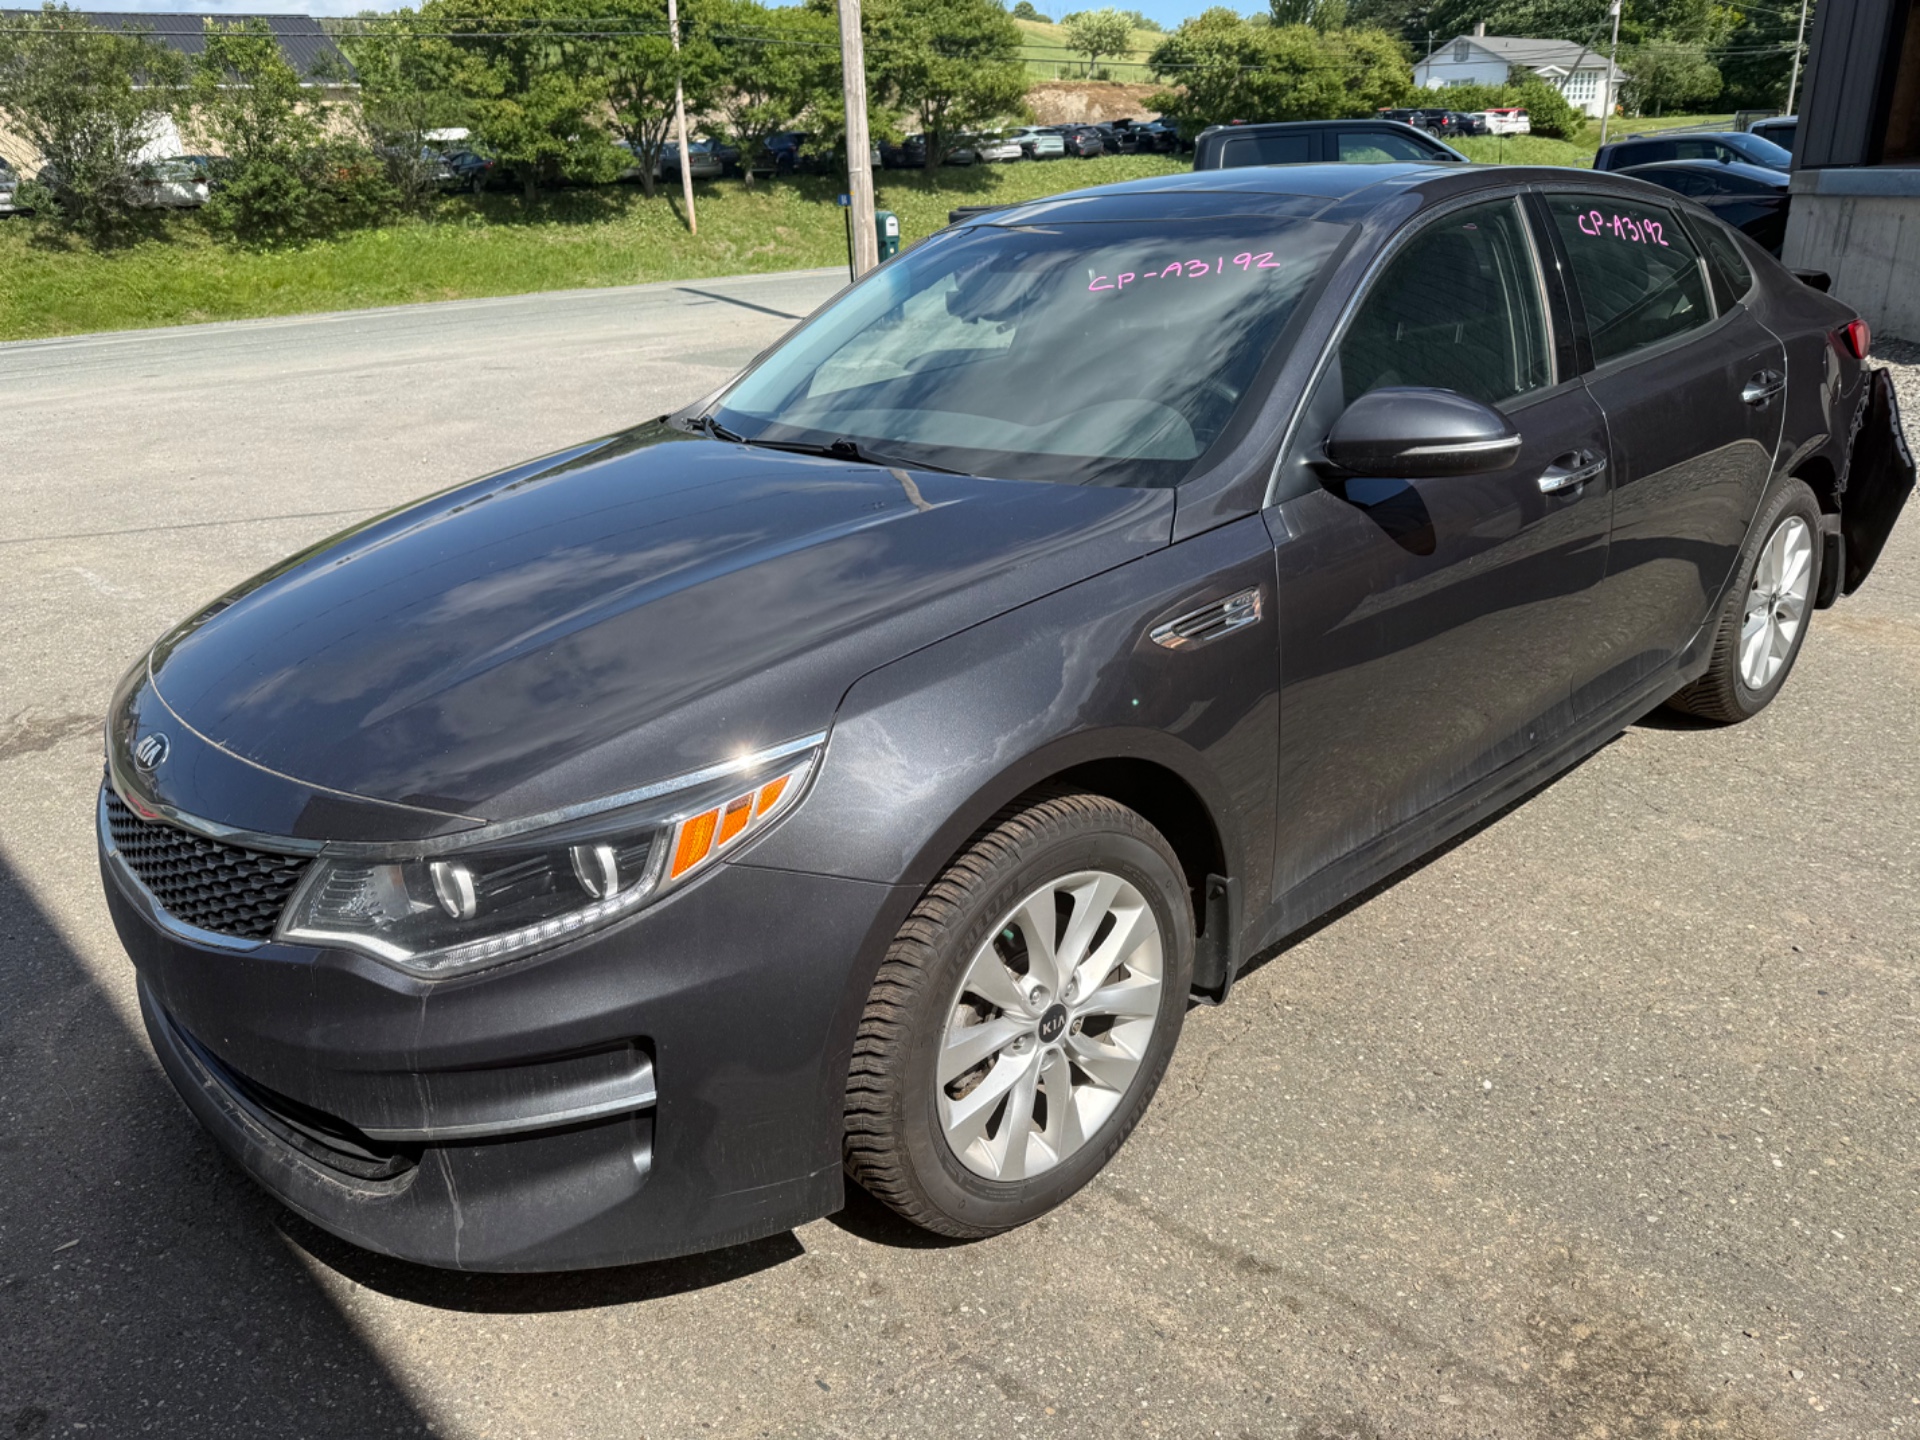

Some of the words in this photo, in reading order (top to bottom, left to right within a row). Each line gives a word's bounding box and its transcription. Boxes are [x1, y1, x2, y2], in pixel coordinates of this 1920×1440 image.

[1578, 210, 1669, 246] CP-A3192
[1088, 252, 1280, 291] CP-A3192
[1042, 1014, 1066, 1036] KIA
